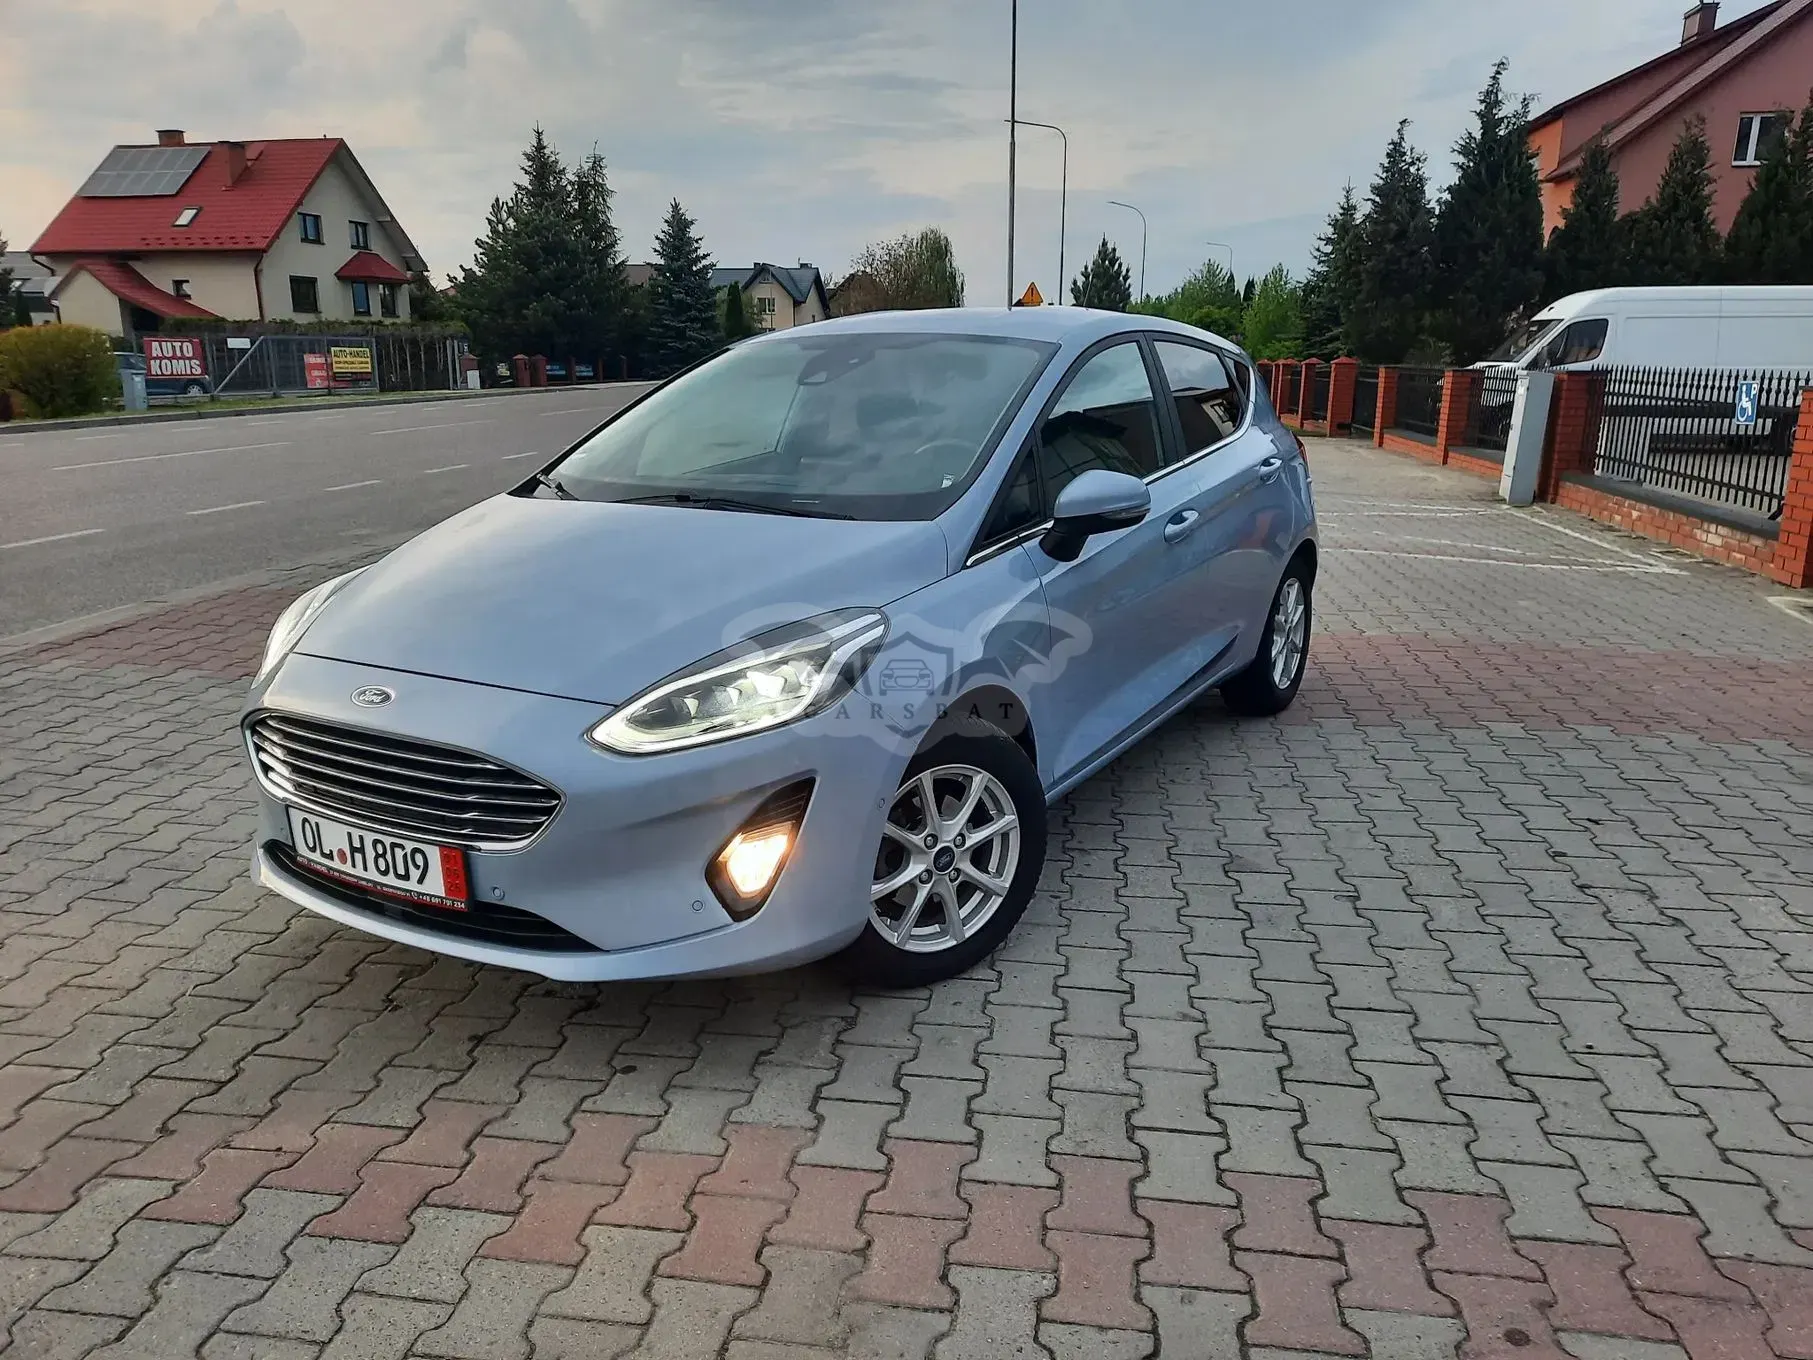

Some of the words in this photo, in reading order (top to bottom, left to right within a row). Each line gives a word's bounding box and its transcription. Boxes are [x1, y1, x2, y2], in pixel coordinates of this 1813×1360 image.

[151, 341, 193, 357] AUTO
[333, 349, 370, 359] AUTO-HANDEL
[150, 359, 202, 375] KOMIS
[1750, 383, 1758, 399] P
[301, 816, 335, 862] OL
[346, 831, 429, 886] H809
